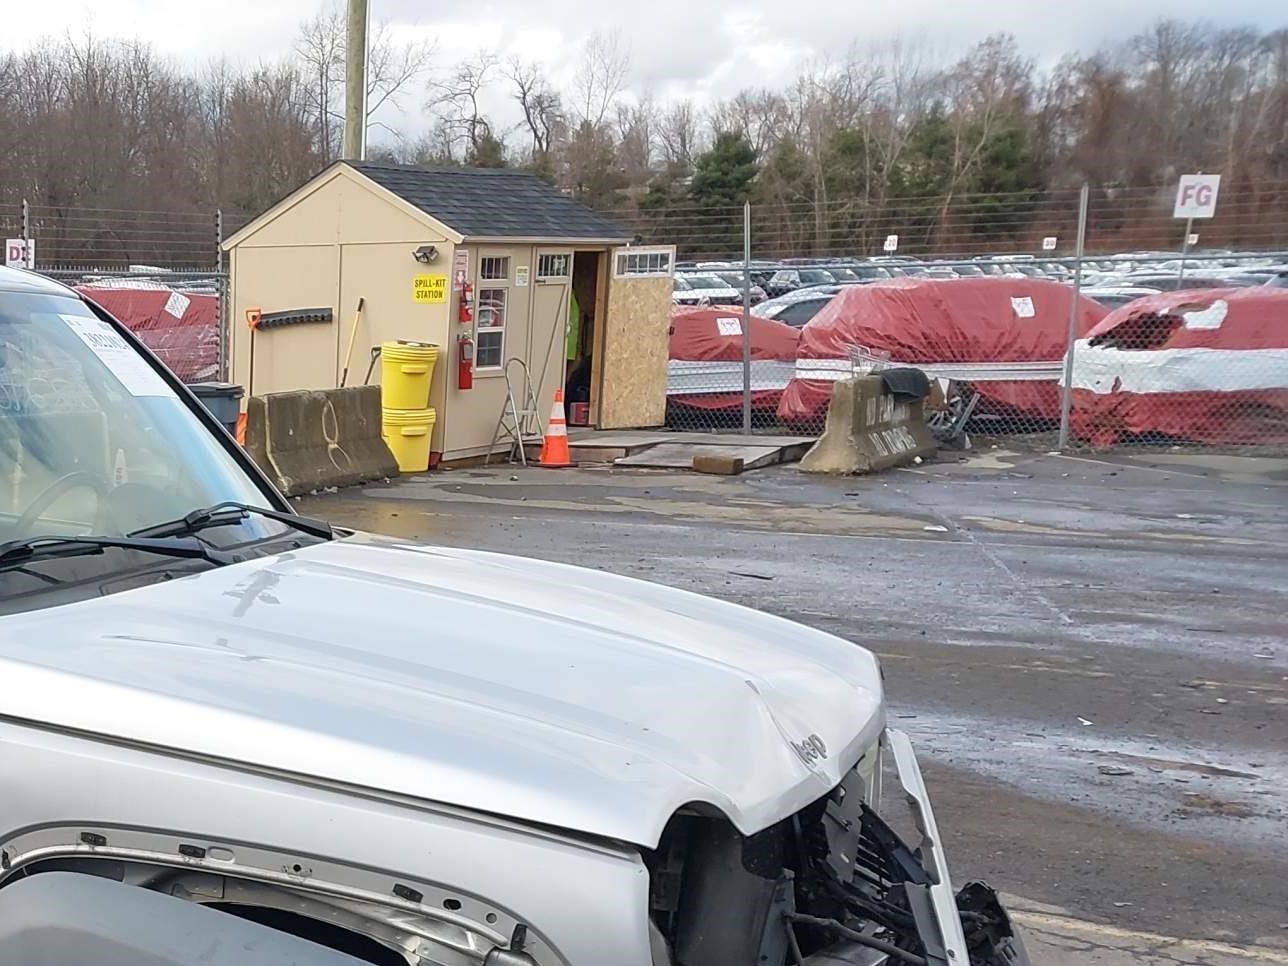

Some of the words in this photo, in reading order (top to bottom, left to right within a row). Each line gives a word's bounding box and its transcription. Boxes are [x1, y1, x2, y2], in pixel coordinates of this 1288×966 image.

[1180, 184, 1213, 207] FG
[414, 279, 447, 289] SPILL-KIT
[415, 289, 444, 300] STATION
